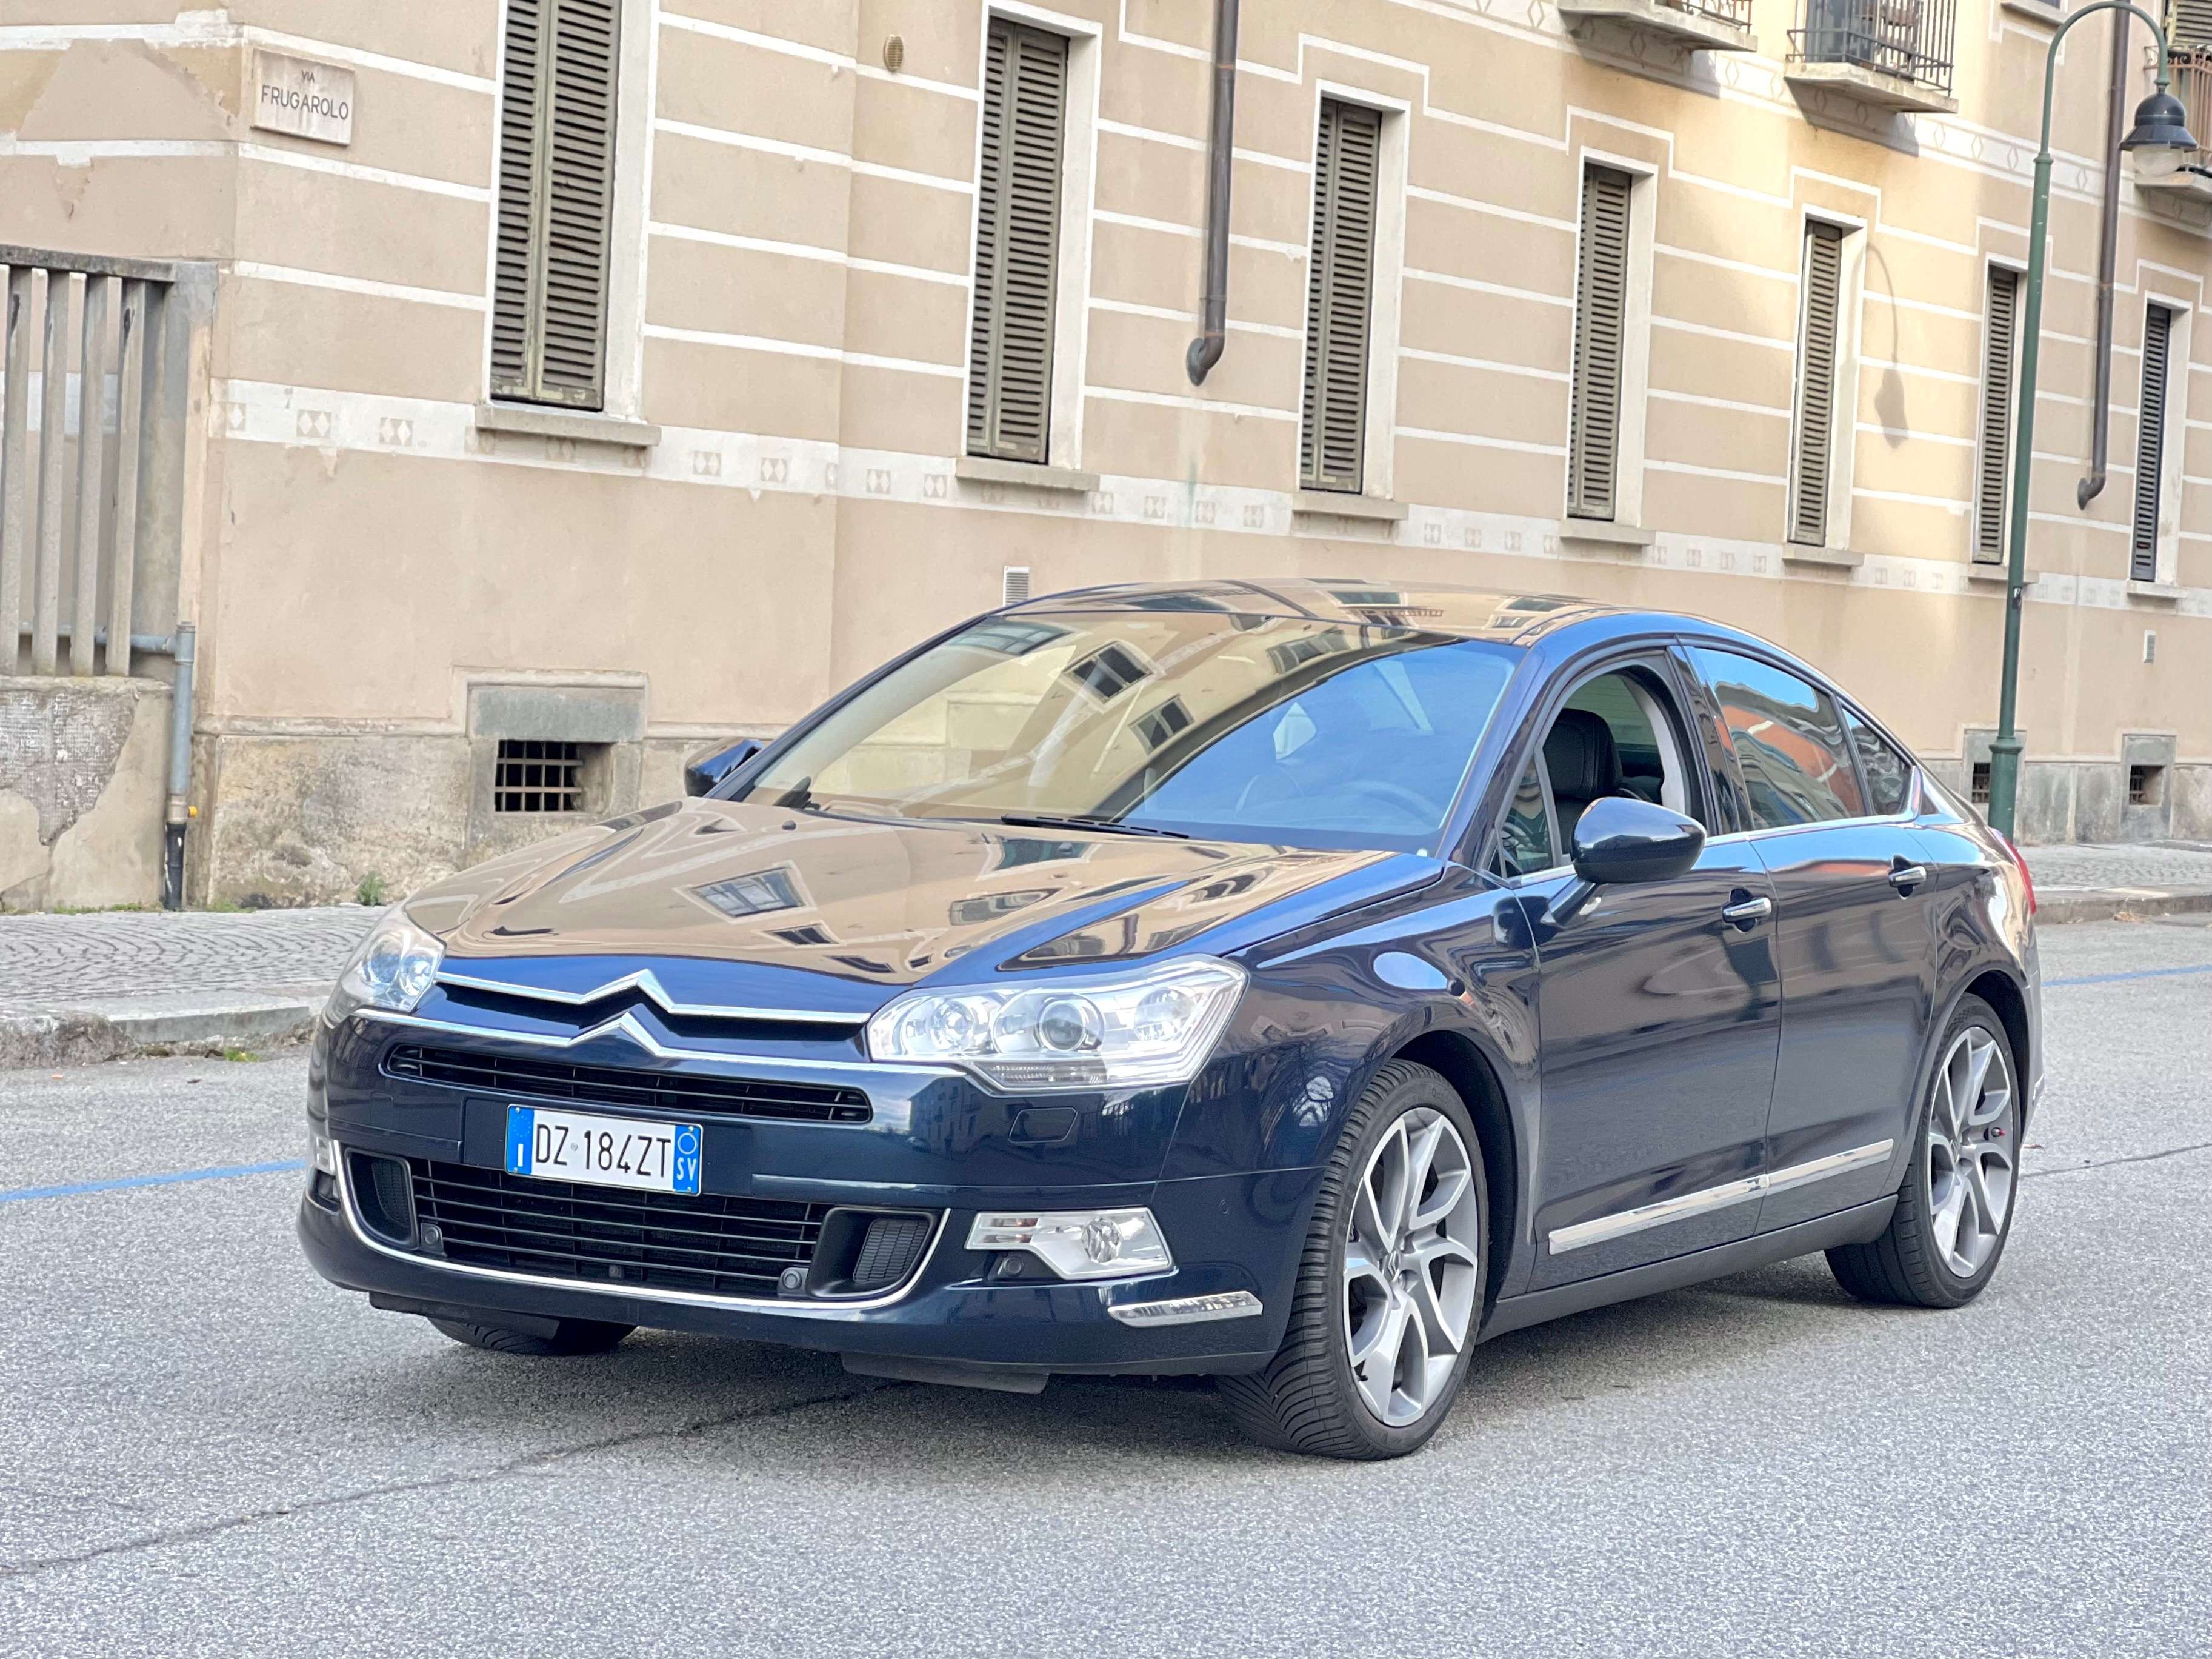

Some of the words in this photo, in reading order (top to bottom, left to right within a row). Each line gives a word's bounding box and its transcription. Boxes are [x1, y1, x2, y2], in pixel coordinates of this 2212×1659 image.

[302, 70, 315, 83] VIA
[261, 84, 349, 120] FRUGAROLO
[536, 1123, 569, 1166] DZ
[583, 1129, 671, 1178] 184ZT
[676, 1157, 697, 1181] SV
